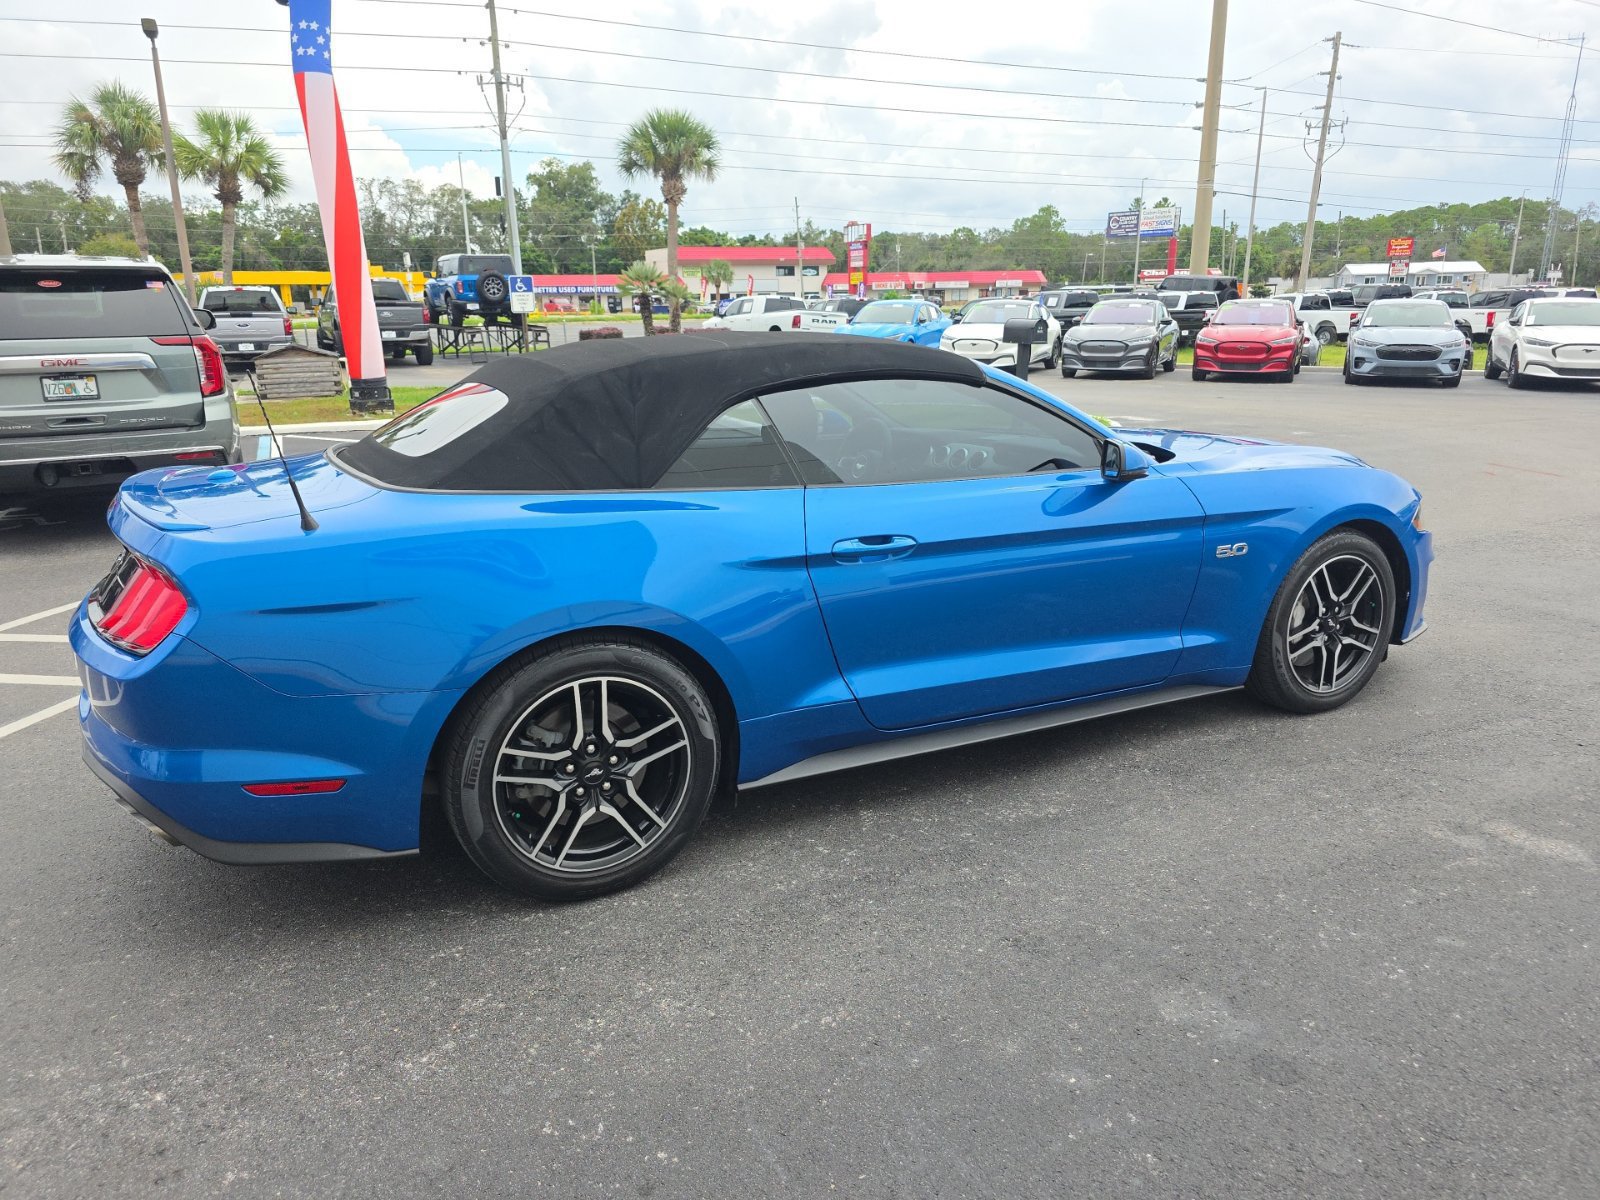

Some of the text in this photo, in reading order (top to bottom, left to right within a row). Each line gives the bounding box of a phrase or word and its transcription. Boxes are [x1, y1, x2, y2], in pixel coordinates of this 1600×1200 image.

[533, 286, 558, 294] BETTER
[40, 358, 88, 367] GMC
[463, 738, 486, 790] PIRELLI
